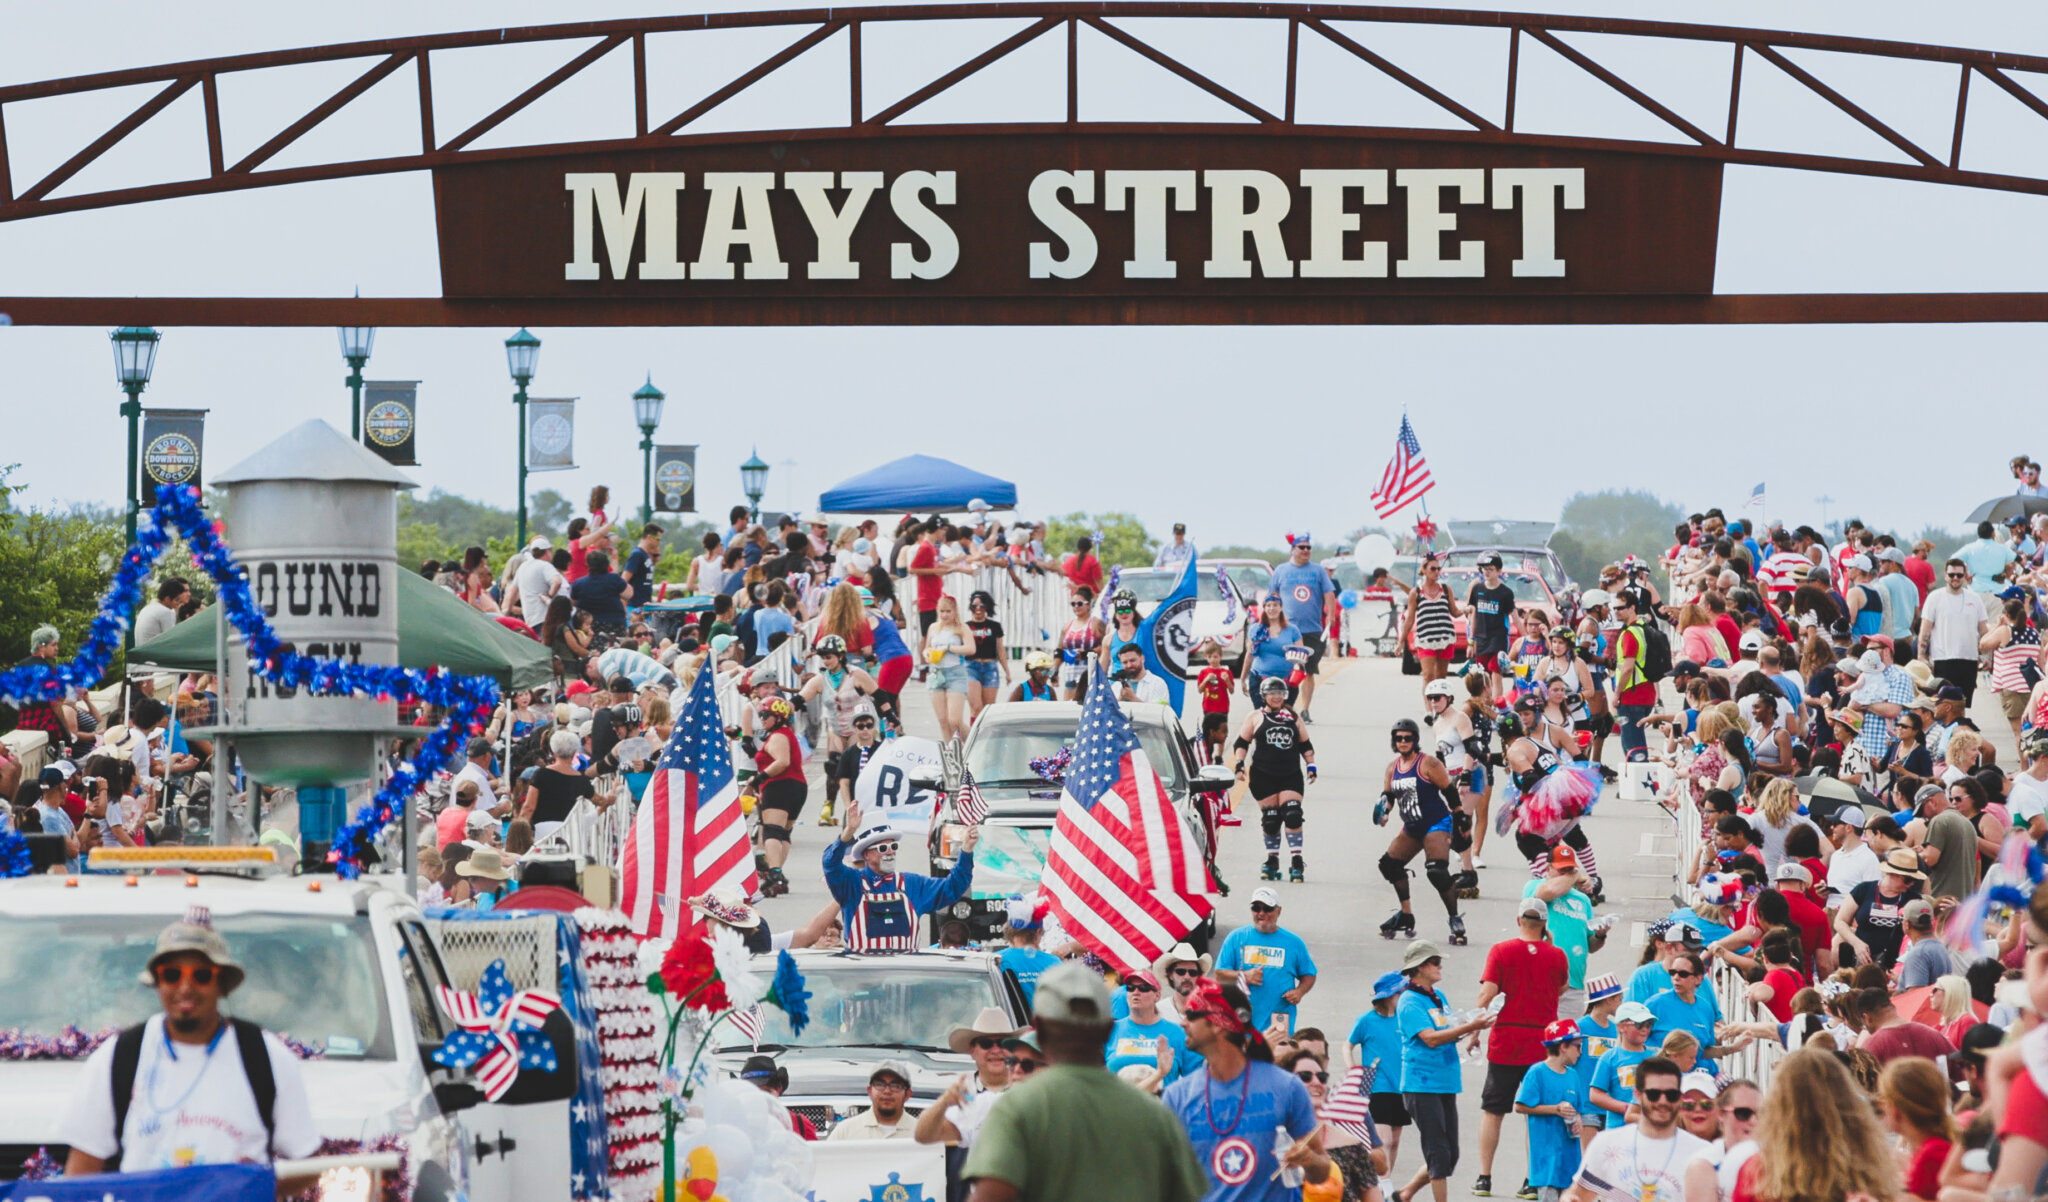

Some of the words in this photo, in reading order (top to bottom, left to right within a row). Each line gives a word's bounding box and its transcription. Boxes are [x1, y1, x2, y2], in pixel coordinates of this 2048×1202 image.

[565, 170, 960, 281] MAYS
[1028, 166, 1585, 280] STREET
[156, 438, 190, 451] ROUND
[149, 455, 194, 464] DOWNTOWN
[158, 467, 184, 481] ROCK
[242, 562, 380, 617] OUND
[625, 706, 642, 722] 101
[1257, 947, 1283, 958] PALM
